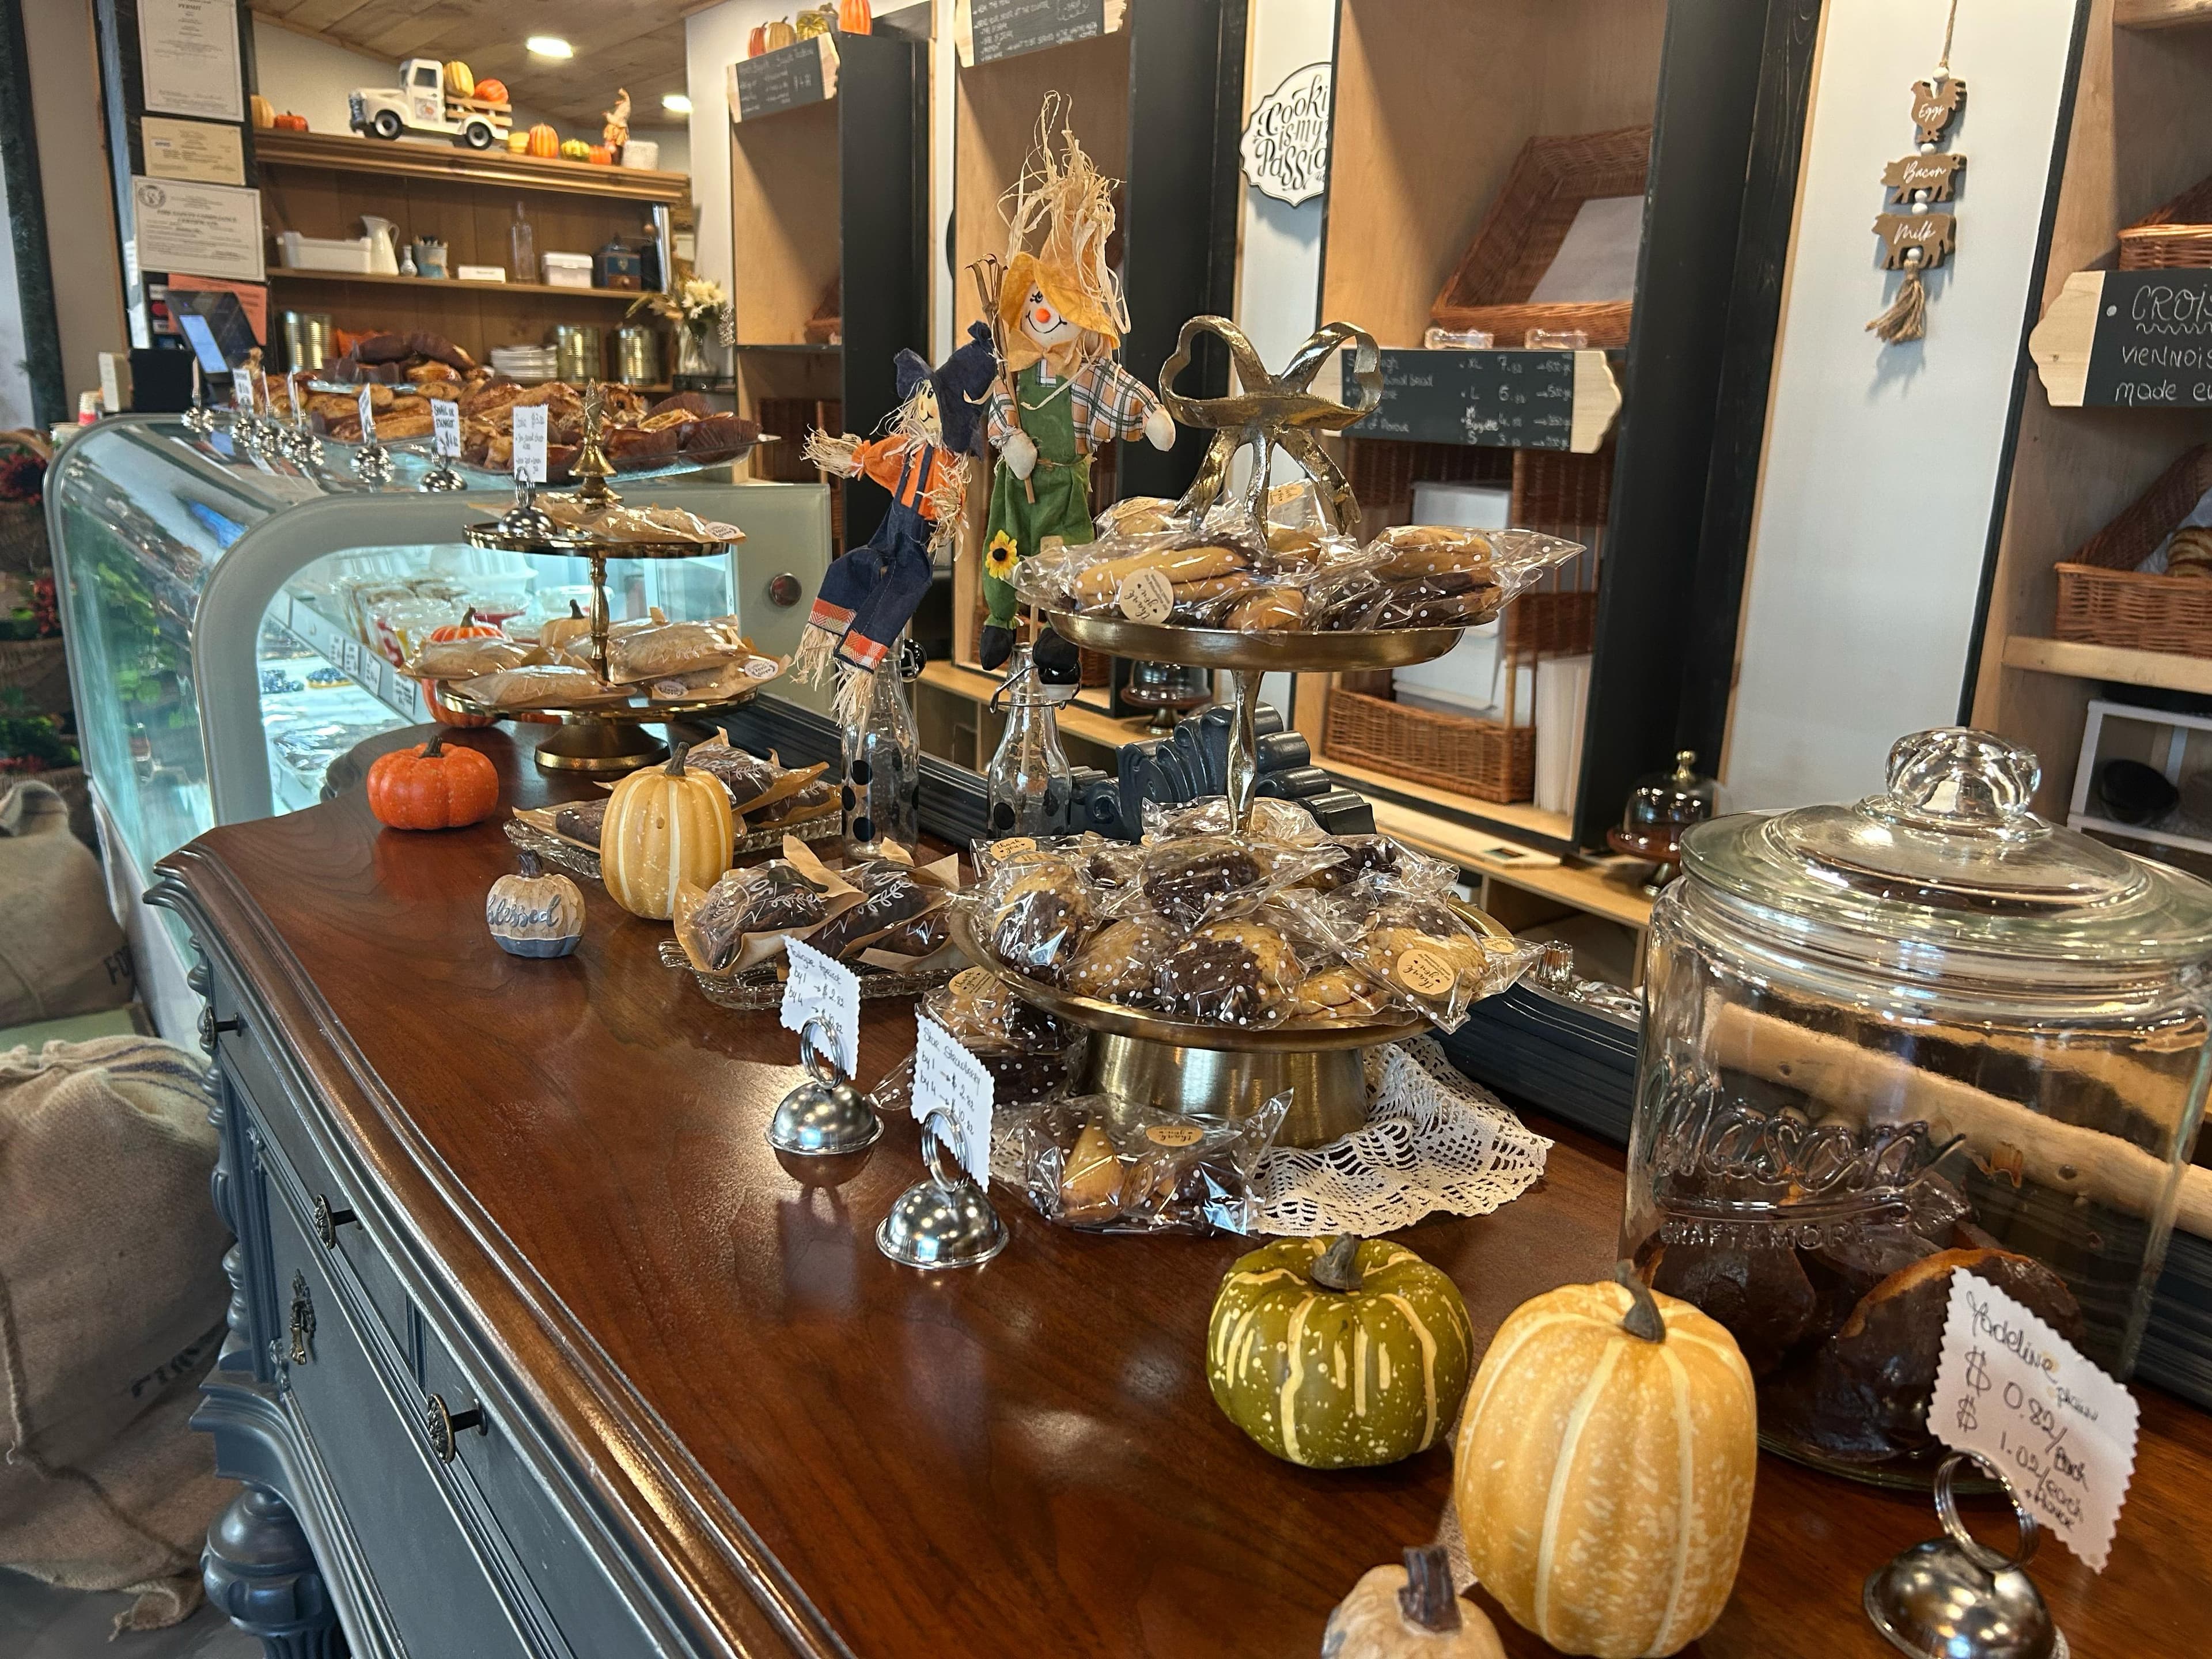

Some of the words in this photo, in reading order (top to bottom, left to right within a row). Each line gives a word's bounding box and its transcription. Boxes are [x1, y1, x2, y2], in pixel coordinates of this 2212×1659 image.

[1919, 103, 1945, 123] Eggs
[1279, 123, 1294, 151] is
[1295, 119, 1324, 153] my
[1903, 160, 1947, 185] Bacon
[1893, 221, 1937, 244] Milk
[2115, 379, 2177, 407] made
[1124, 589, 1150, 620] thank
[1141, 589, 1159, 608] you
[997, 839, 1021, 850] thank
[1006, 844, 1020, 854] you
[488, 893, 561, 927] blessed
[1402, 964, 1434, 990] thank
[1418, 964, 1440, 979] you
[1964, 1344, 1992, 1398] $
[1956, 1393, 1978, 1434] $
